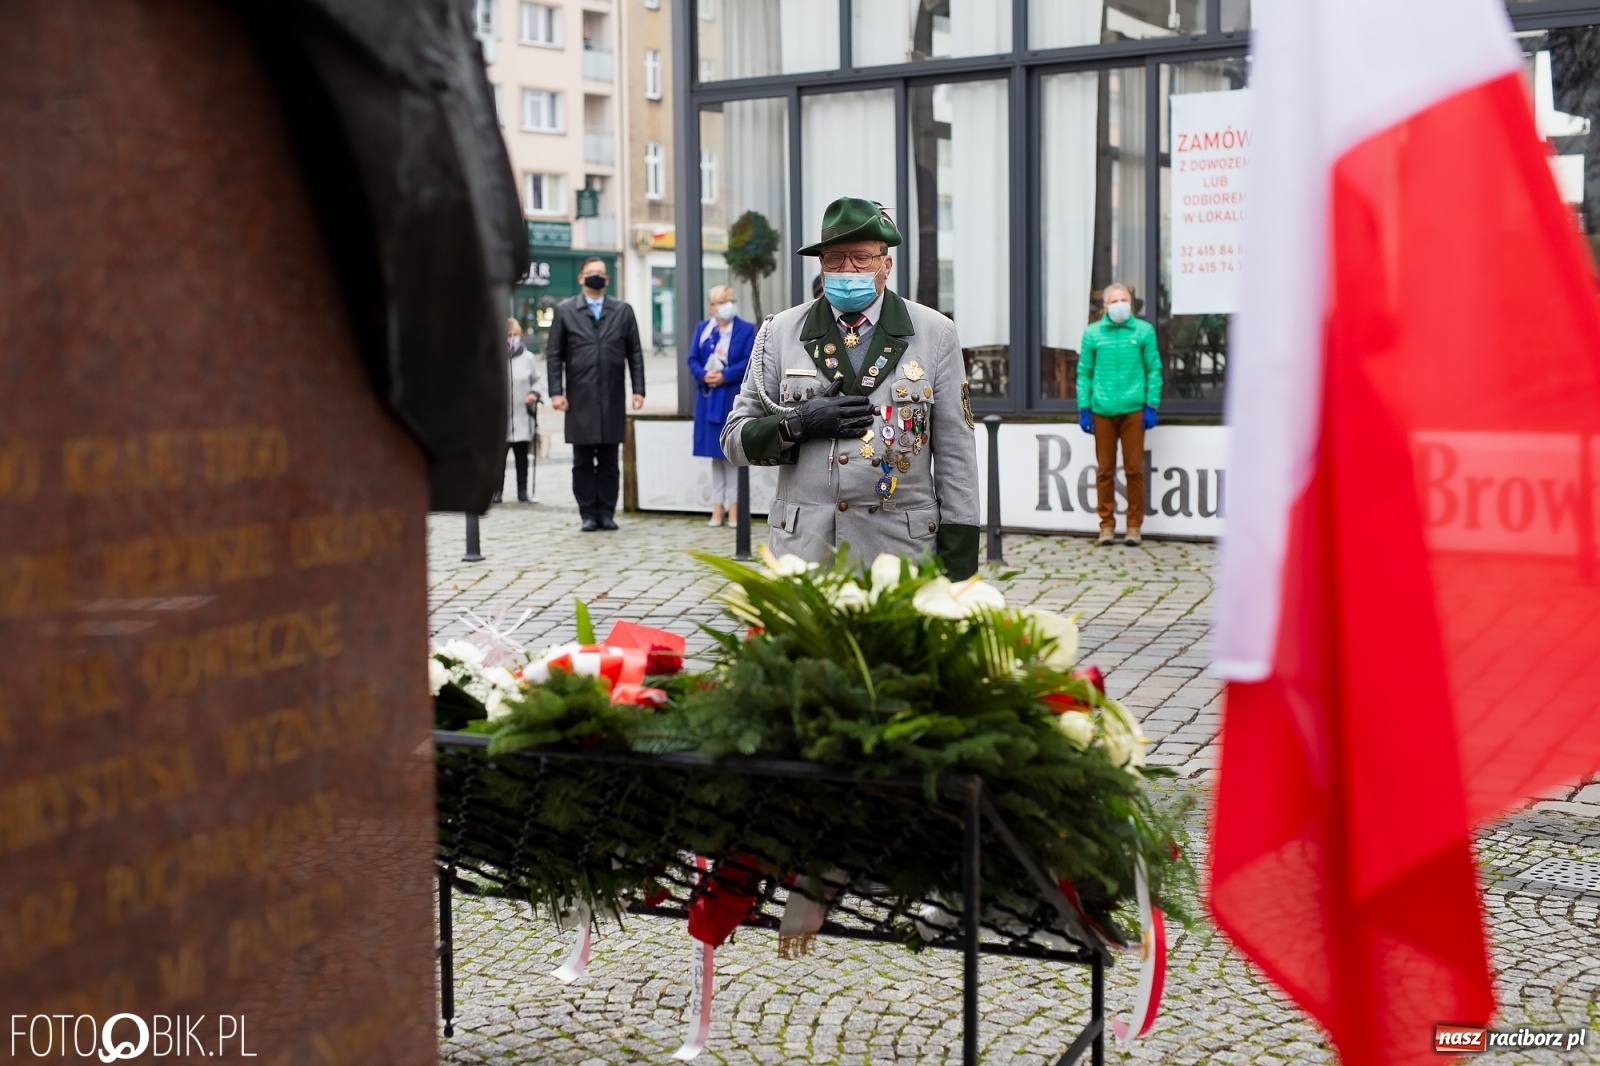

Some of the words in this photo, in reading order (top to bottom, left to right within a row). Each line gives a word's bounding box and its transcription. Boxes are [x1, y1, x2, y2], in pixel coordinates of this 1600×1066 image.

[1177, 125, 1253, 152] ZAMÓW
[1203, 175, 1228, 188] LUB
[1184, 212, 1194, 223] W
[1180, 245, 1193, 257] 32
[1198, 244, 1215, 256] 415
[1219, 243, 1234, 256] 84
[1181, 262, 1194, 274] 32
[1199, 261, 1216, 273] 415
[1220, 260, 1234, 272] 74
